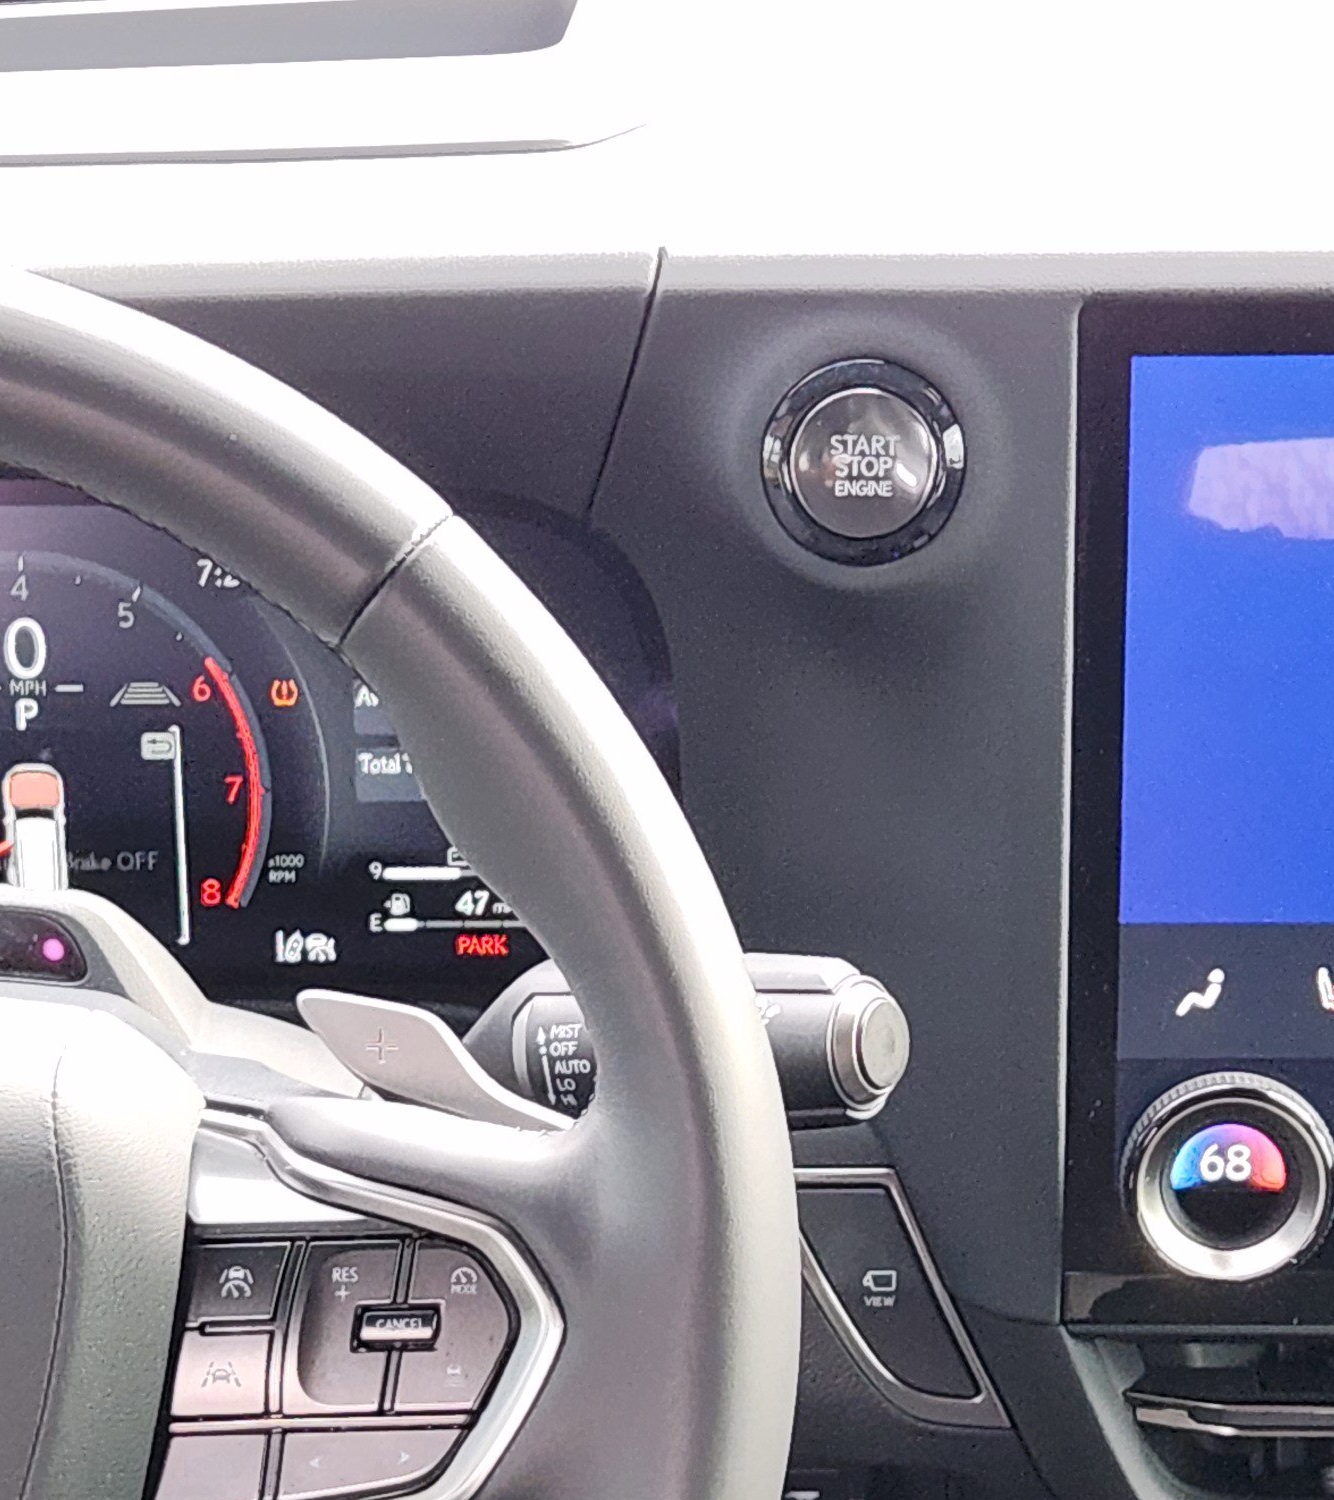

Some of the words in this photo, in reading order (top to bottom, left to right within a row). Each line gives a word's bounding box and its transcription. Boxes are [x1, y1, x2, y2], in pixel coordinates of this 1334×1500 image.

[830, 434, 900, 456] START
[834, 456, 893, 477] STOP
[835, 480, 893, 497] ENGINE
[10, 575, 28, 601] 4
[117, 602, 135, 629] 5
[3, 617, 47, 679] 0
[9, 679, 47, 696] MPH
[192, 676, 211, 701] 6
[15, 698, 39, 731] P
[357, 752, 402, 775] Total
[225, 775, 244, 804] 7
[117, 851, 159, 871] OFF
[269, 869, 296, 883] RPM
[200, 879, 221, 906] 8
[455, 890, 489, 916] 47
[369, 913, 383, 932] E
[456, 934, 509, 957] PARK
[549, 1041, 578, 1057] OFF
[555, 1059, 591, 1075] AUTO
[556, 1078, 576, 1092] LO
[1199, 1144, 1251, 1182] 68
[331, 1267, 359, 1283] RES
[450, 1283, 478, 1295] MODE
[864, 1296, 896, 1307] VIEW
[375, 1317, 426, 1330] CANCEL
